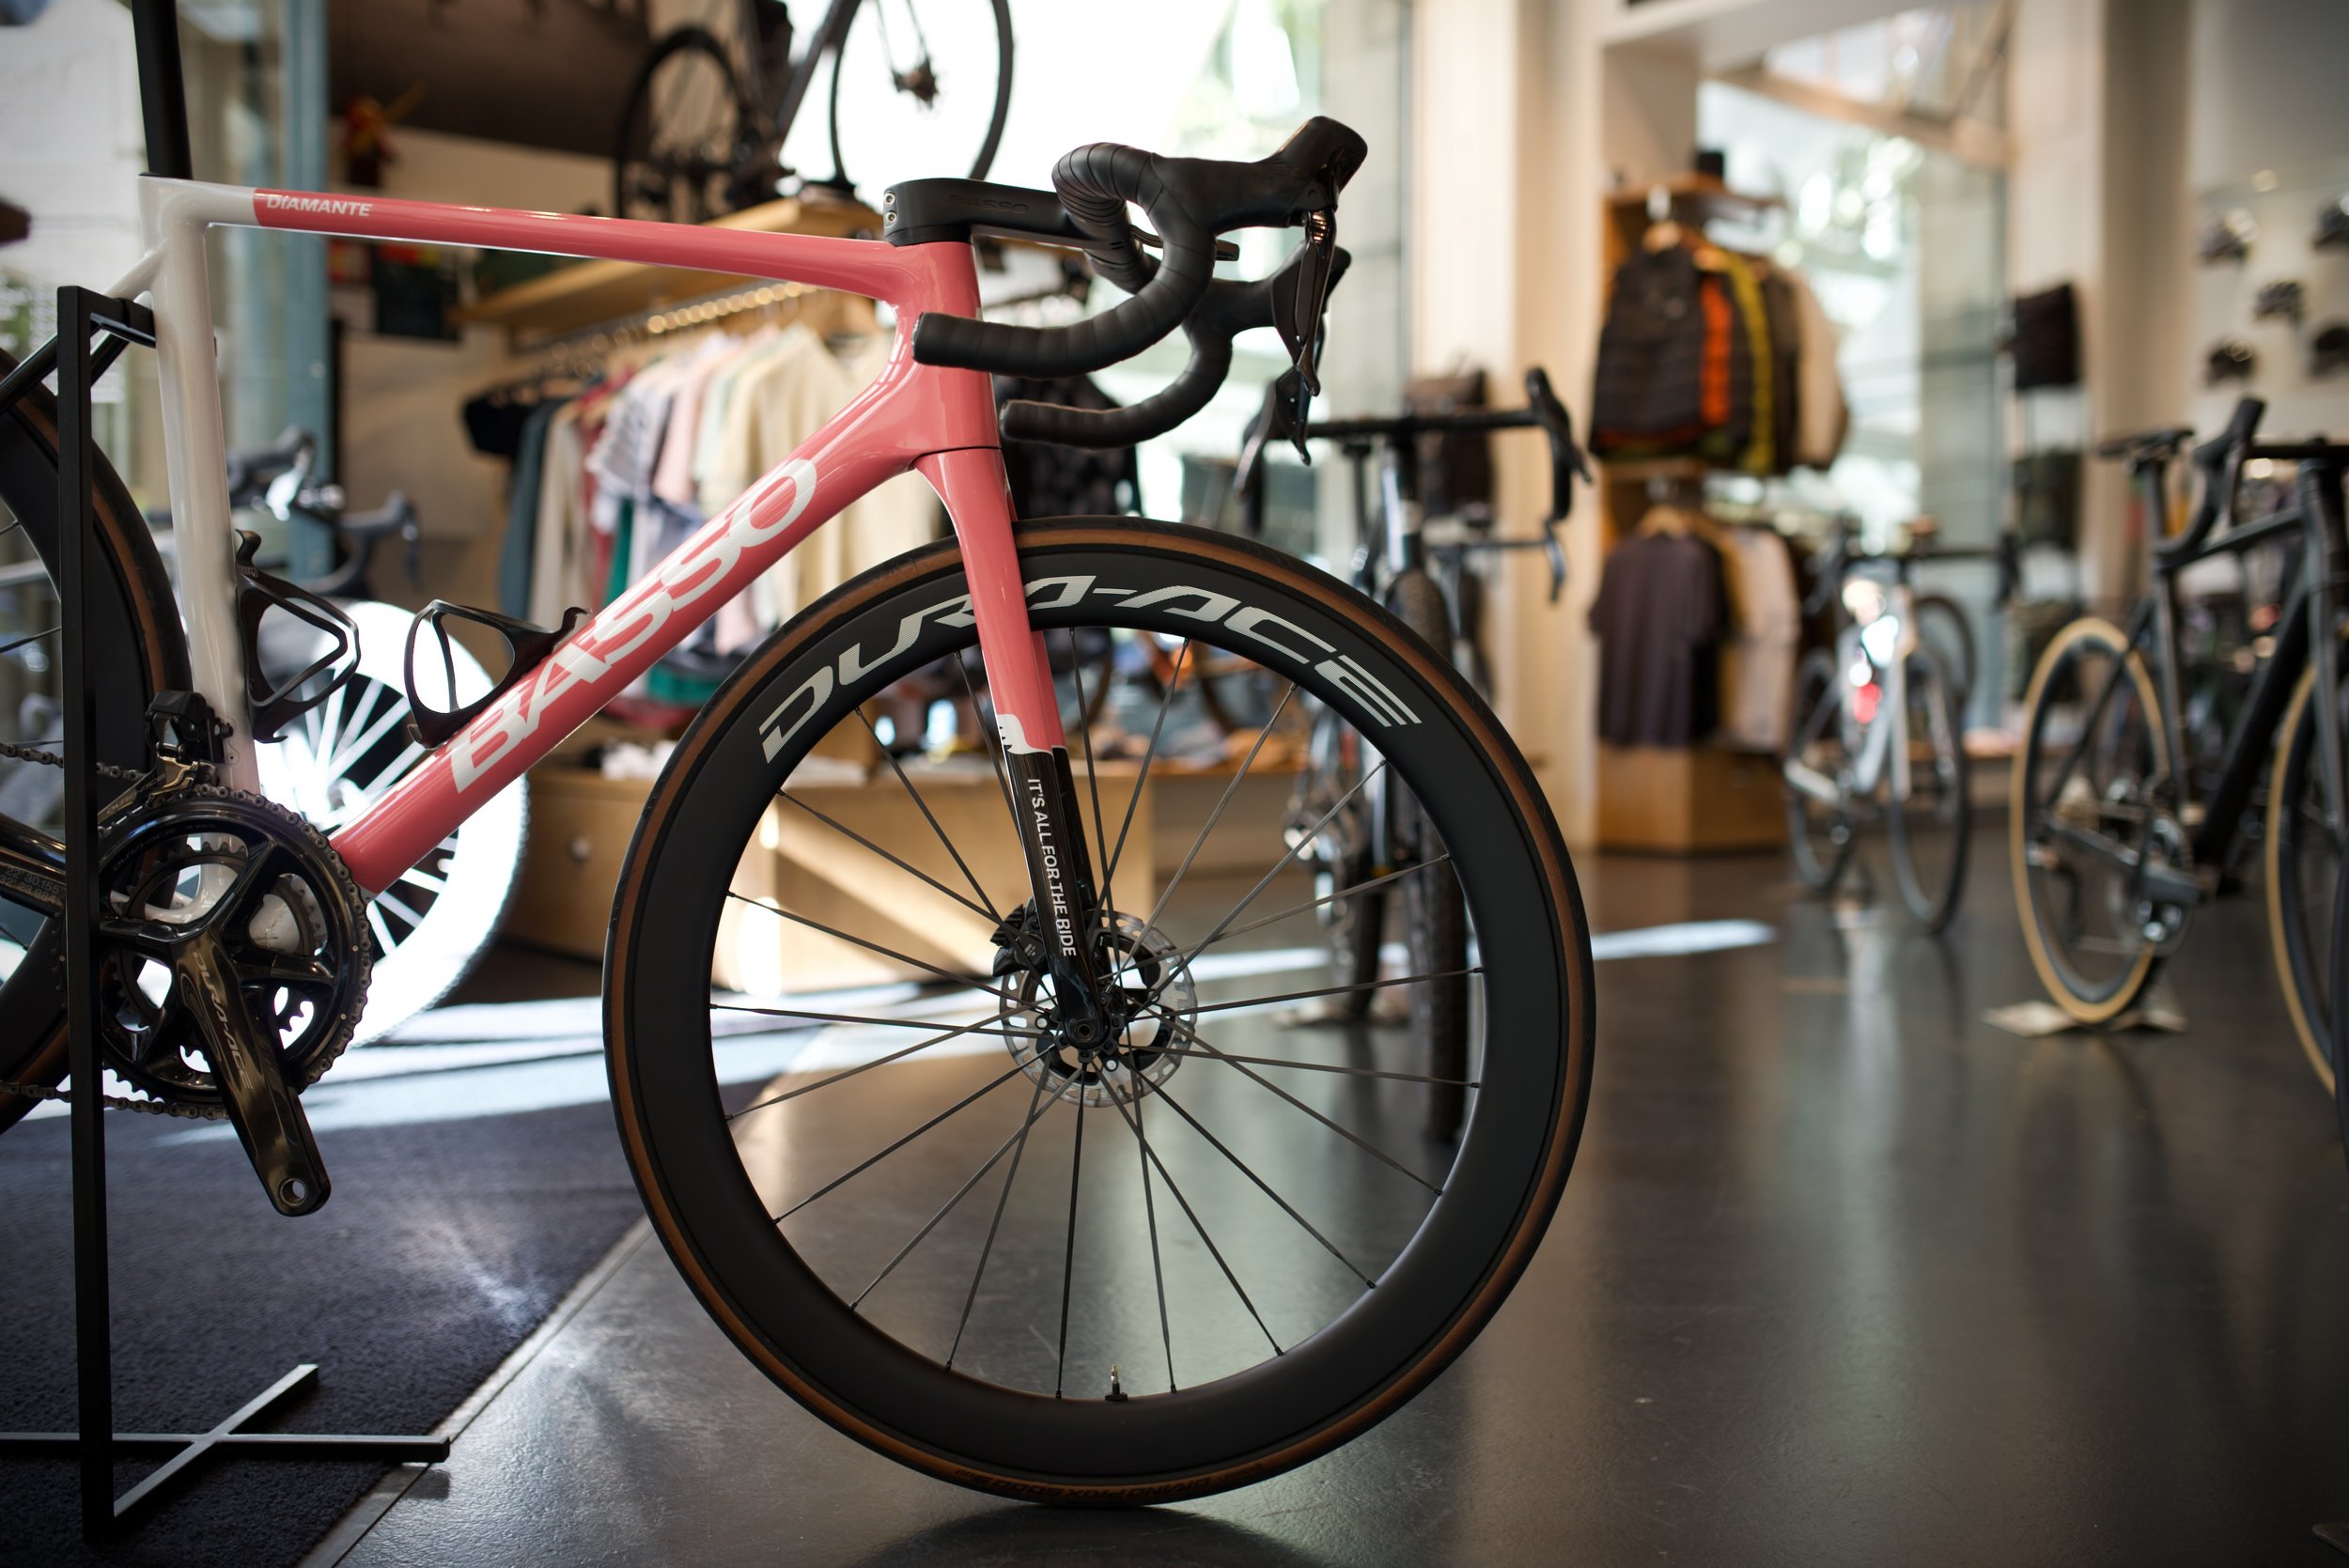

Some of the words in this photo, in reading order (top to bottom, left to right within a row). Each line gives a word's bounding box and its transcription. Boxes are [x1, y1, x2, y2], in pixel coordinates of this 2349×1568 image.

[266, 194, 373, 217] DIAMANTE
[447, 458, 817, 794] BASSO
[759, 575, 1422, 764] DURA-ACE
[1028, 779, 1046, 808] IT'S
[1034, 811, 1052, 844] ALL
[1042, 845, 1060, 880] FOR
[1050, 881, 1068, 916] THE
[1055, 915, 1077, 957] RIDE
[193, 951, 254, 1090] DURA-ACE
